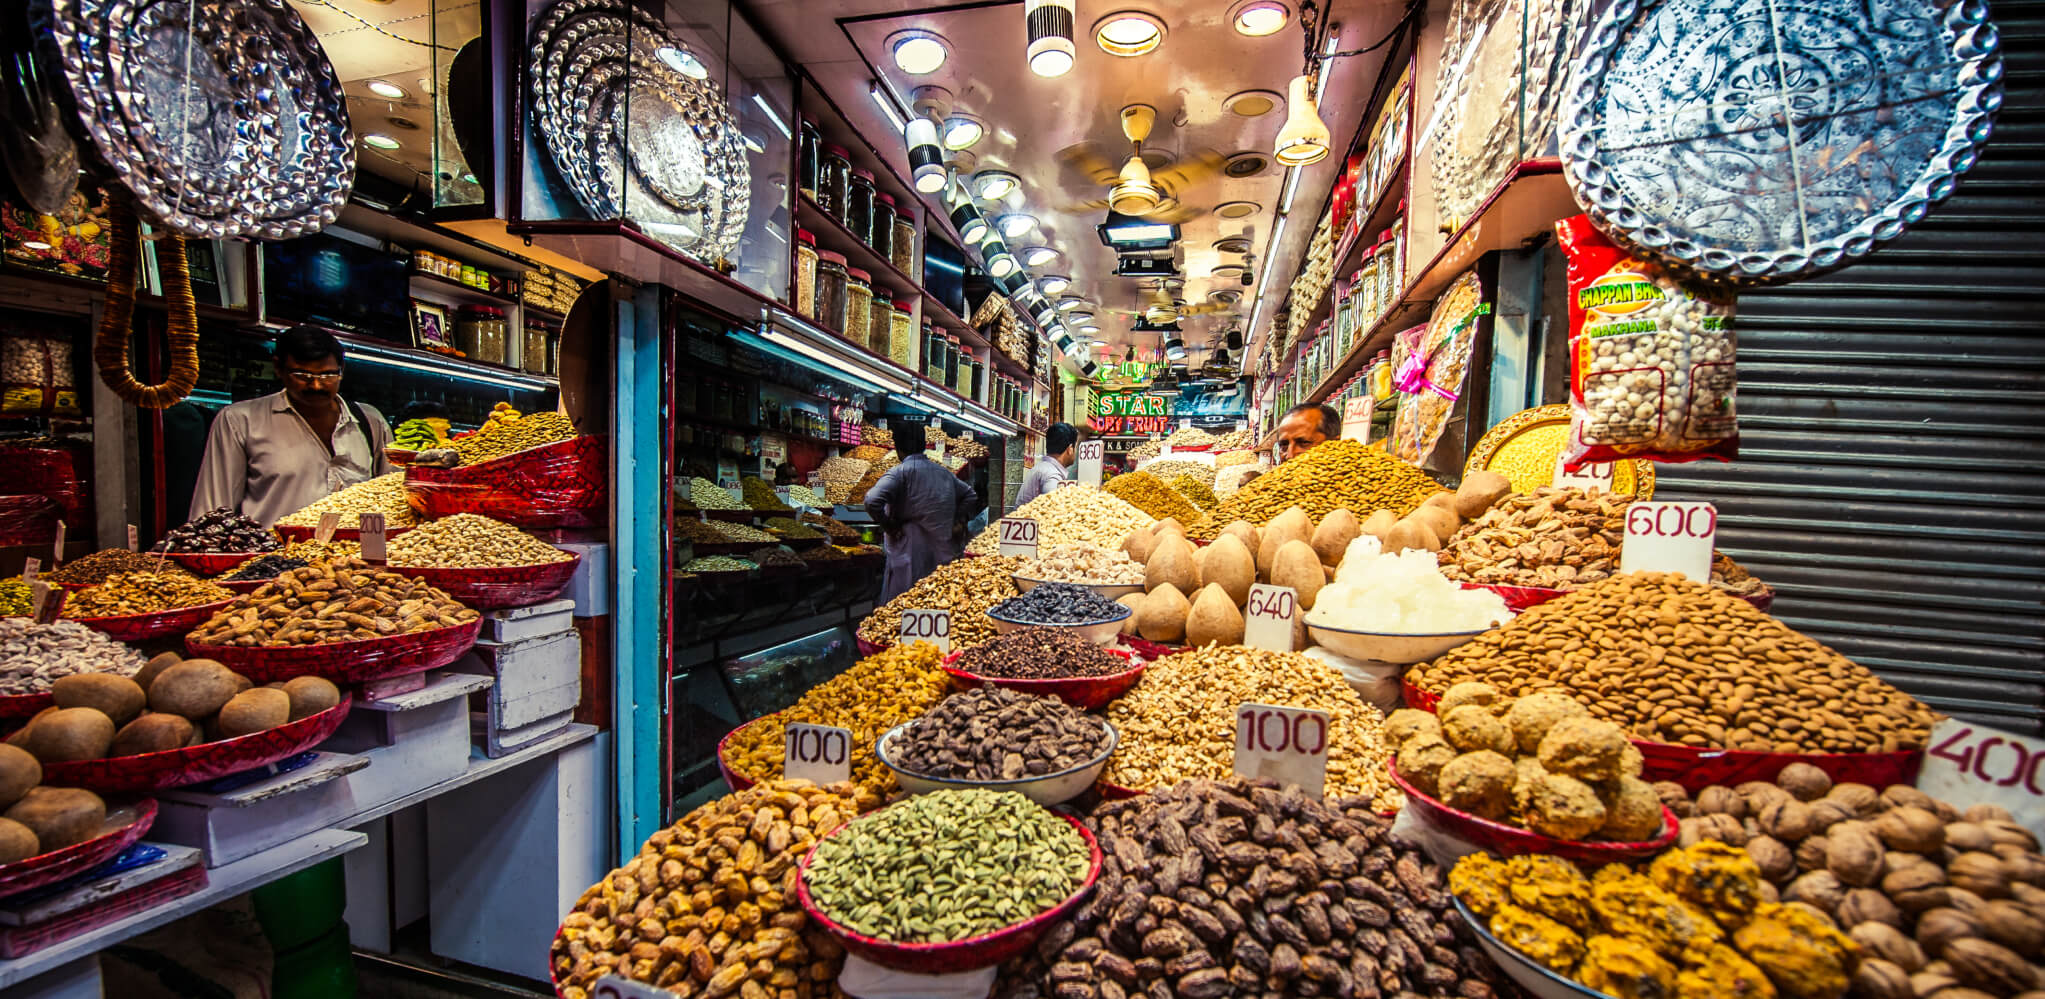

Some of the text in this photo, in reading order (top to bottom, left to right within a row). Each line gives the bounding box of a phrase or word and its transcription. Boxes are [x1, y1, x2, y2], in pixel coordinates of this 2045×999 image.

[1578, 283, 1633, 309] CHAPPAN
[1591, 319, 1658, 338] MAKHANA
[1100, 396, 1166, 416] STAR
[1096, 416, 1169, 432] DRY FRUIT
[1079, 443, 1100, 460] 860
[1562, 461, 1613, 480] 20
[360, 515, 384, 534] 200
[1000, 521, 1036, 541] 720
[1627, 505, 1716, 539] 600
[1249, 589, 1293, 620] 640
[903, 613, 950, 638] 200
[1241, 710, 1326, 755] 100
[788, 727, 847, 765] 100
